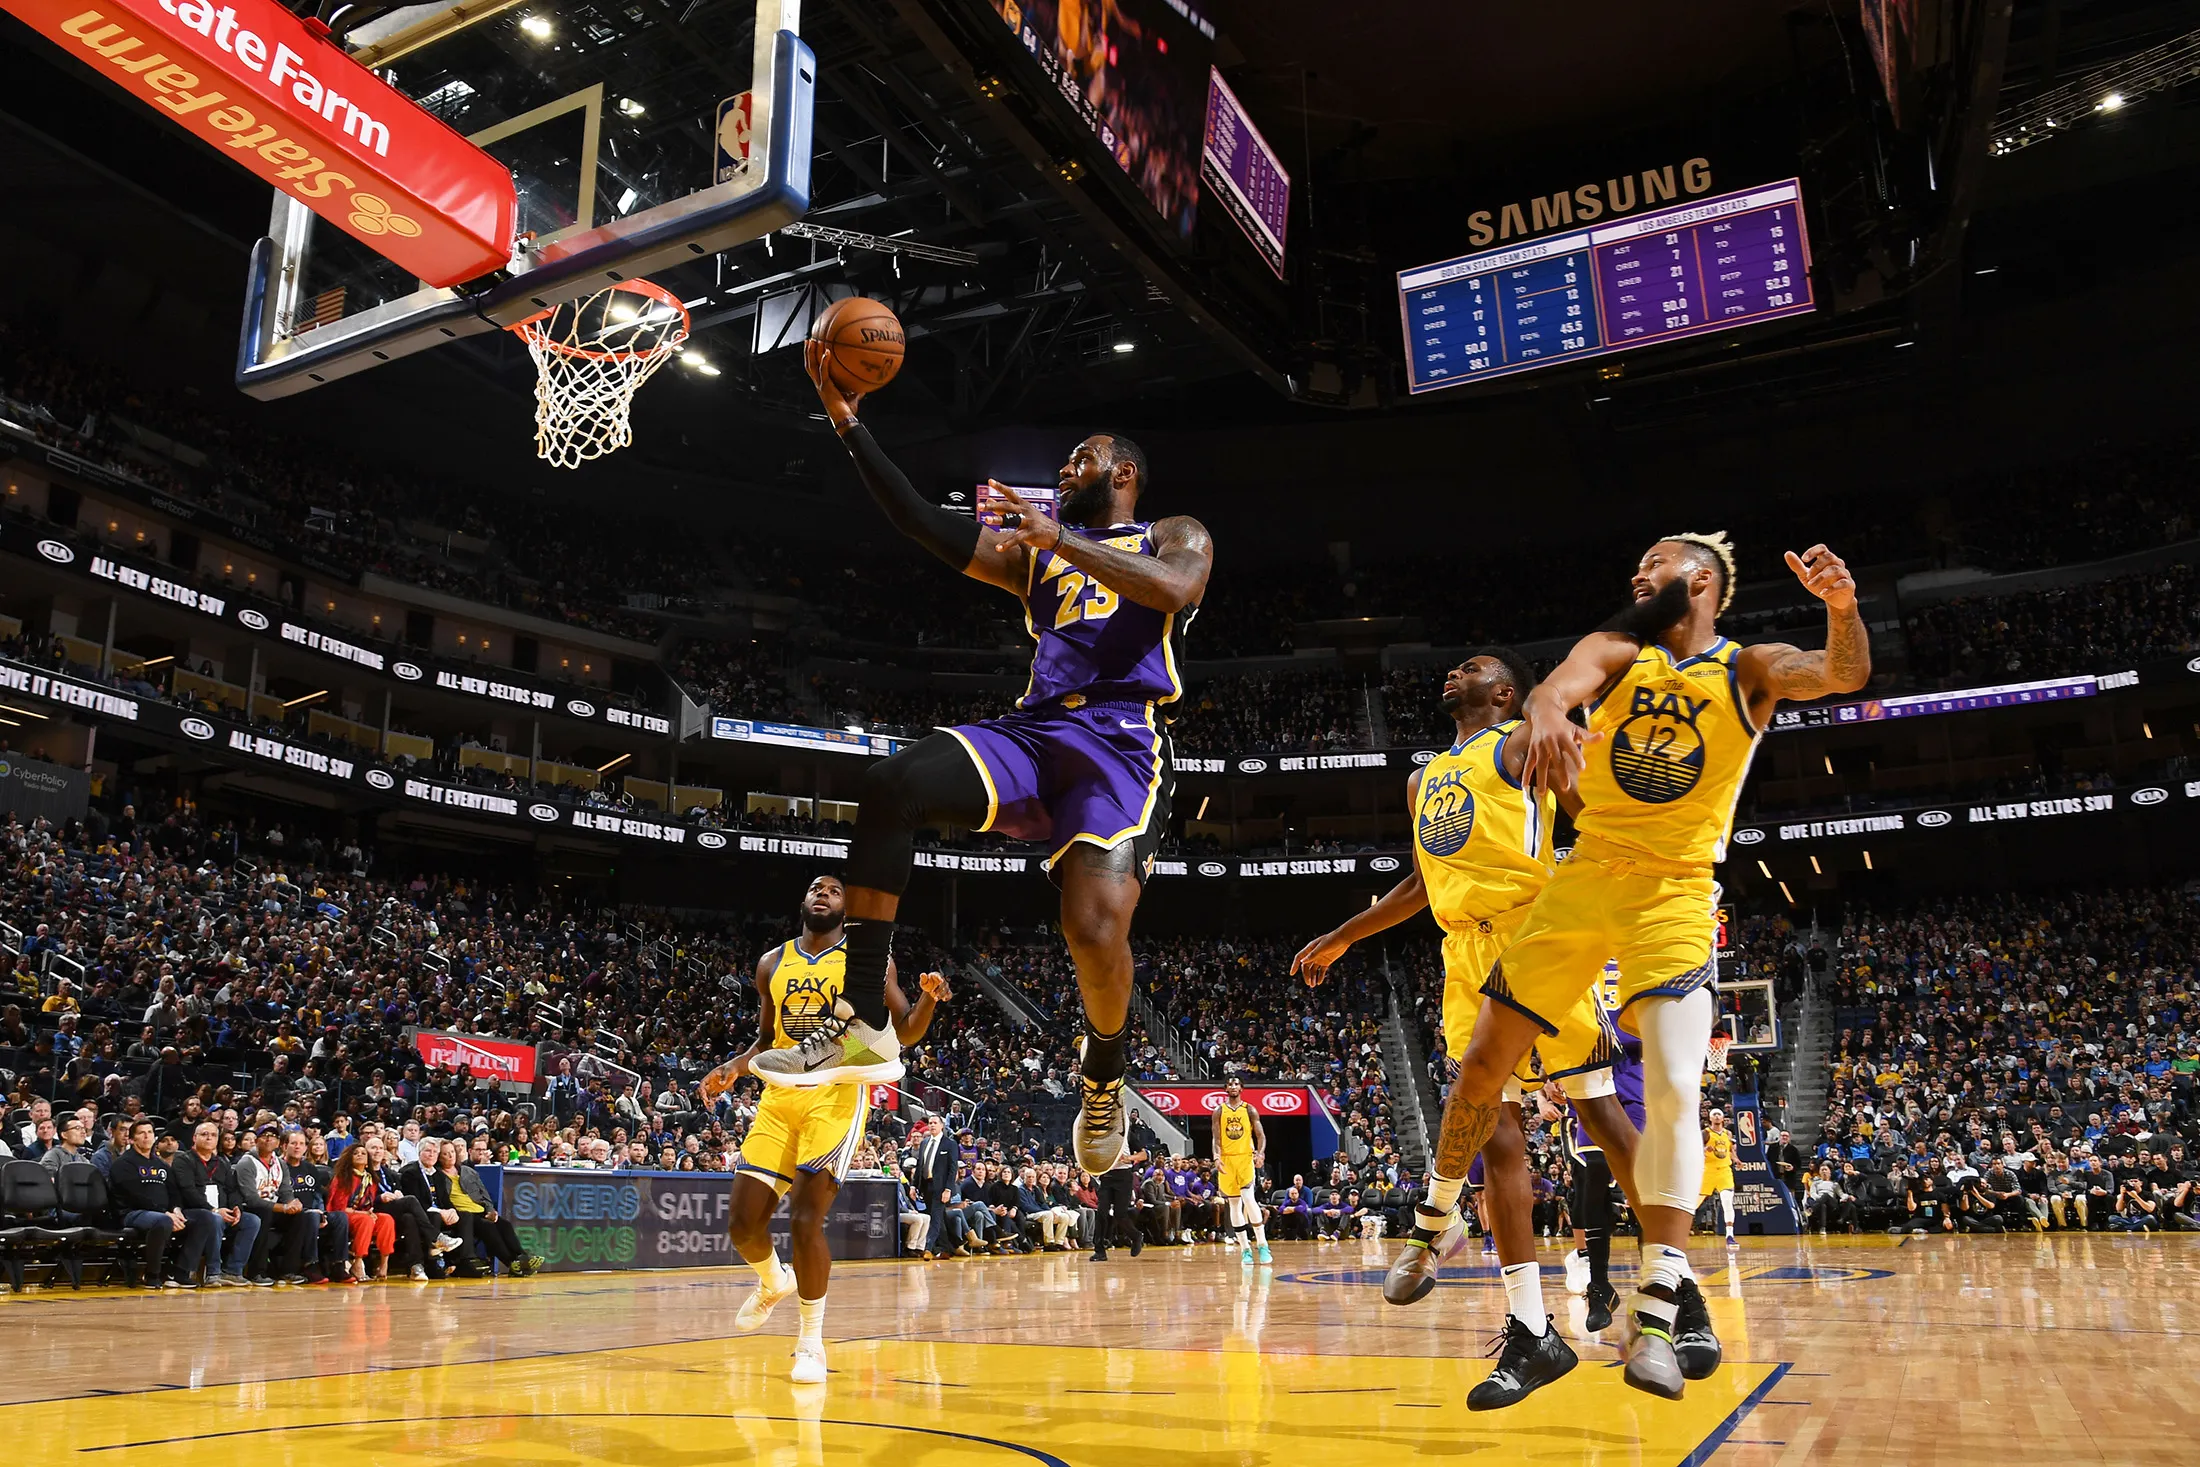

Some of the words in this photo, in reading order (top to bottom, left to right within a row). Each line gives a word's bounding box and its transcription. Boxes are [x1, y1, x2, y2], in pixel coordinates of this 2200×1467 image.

[1468, 158, 1712, 246] SAMSUNG
[1637, 221, 1654, 232] LOS
[1657, 211, 1693, 228] ANGELES
[1695, 204, 1719, 221] TEAM
[1721, 199, 1748, 214] STATS
[1774, 210, 1781, 220] 1
[1441, 264, 1470, 278] GOLDEN
[1473, 256, 1497, 269] STATE
[1499, 250, 1519, 264] TEAM
[1522, 245, 1547, 259] STATS
[1567, 257, 1575, 267] 4
[1672, 249, 1680, 260] 7
[1475, 294, 1482, 304] 4
[1677, 282, 1684, 292] 7
[91, 557, 149, 590] ALL-NEW
[151, 578, 197, 607] SELTOS
[199, 595, 224, 615] SUV
[1054, 571, 1119, 630] 23
[282, 623, 307, 644] GIVE
[308, 632, 320, 648] IT
[321, 636, 383, 669] EVERYTHING
[0, 666, 31, 691] GIVE
[32, 676, 49, 695] IT
[51, 681, 138, 720] EVERYTHING
[437, 672, 487, 694] ALL-NEW
[489, 683, 530, 703] SELTOS
[532, 692, 554, 708] SUV
[1660, 680, 1684, 691] The
[607, 708, 630, 725] GIVE
[632, 714, 643, 727] IT
[1630, 686, 1712, 727] BAY
[1839, 707, 1857, 720] 82
[229, 731, 284, 759] ALL-NEW
[285, 746, 328, 772] SELTOS
[329, 759, 353, 778] SUV
[1644, 725, 1676, 758] 12
[1204, 759, 1225, 772] SUV
[1280, 758, 1305, 770] GIVE
[1307, 757, 1318, 769] IT
[1320, 754, 1386, 768] EVERYTHING
[13, 767, 68, 789] CyberPolicy
[1425, 767, 1472, 800] BAY
[405, 780, 430, 799] GIVE
[431, 786, 443, 801] IT
[445, 789, 517, 815] EVERYTHING
[1434, 792, 1456, 821] 22
[1969, 803, 2027, 822] ALL-NEW
[2030, 798, 2082, 816] SELTOS
[2084, 795, 2112, 811] SUV
[573, 811, 621, 832] ALL-NEW
[622, 820, 662, 839] SELTOS
[663, 827, 685, 843] SUV
[1780, 824, 1809, 839] GIVE
[1811, 823, 1823, 836] IT
[1826, 815, 1904, 835] EVERYTHING
[740, 836, 766, 851] GIVE
[768, 839, 780, 852] IT
[782, 840, 848, 858] EVERYTHING
[914, 853, 959, 869] ALL-NEW
[961, 857, 1001, 871] SELTOS
[1004, 859, 1026, 872] SUV
[1240, 862, 1288, 876] ALL-NEW
[1290, 860, 1331, 874] SELTOS
[1333, 859, 1355, 872] SUV
[786, 977, 829, 994] BAY
[799, 996, 810, 1014] 7
[513, 1182, 639, 1220] SIXERS
[659, 1192, 711, 1226] SAT,
[515, 1226, 637, 1263] BUCKS
